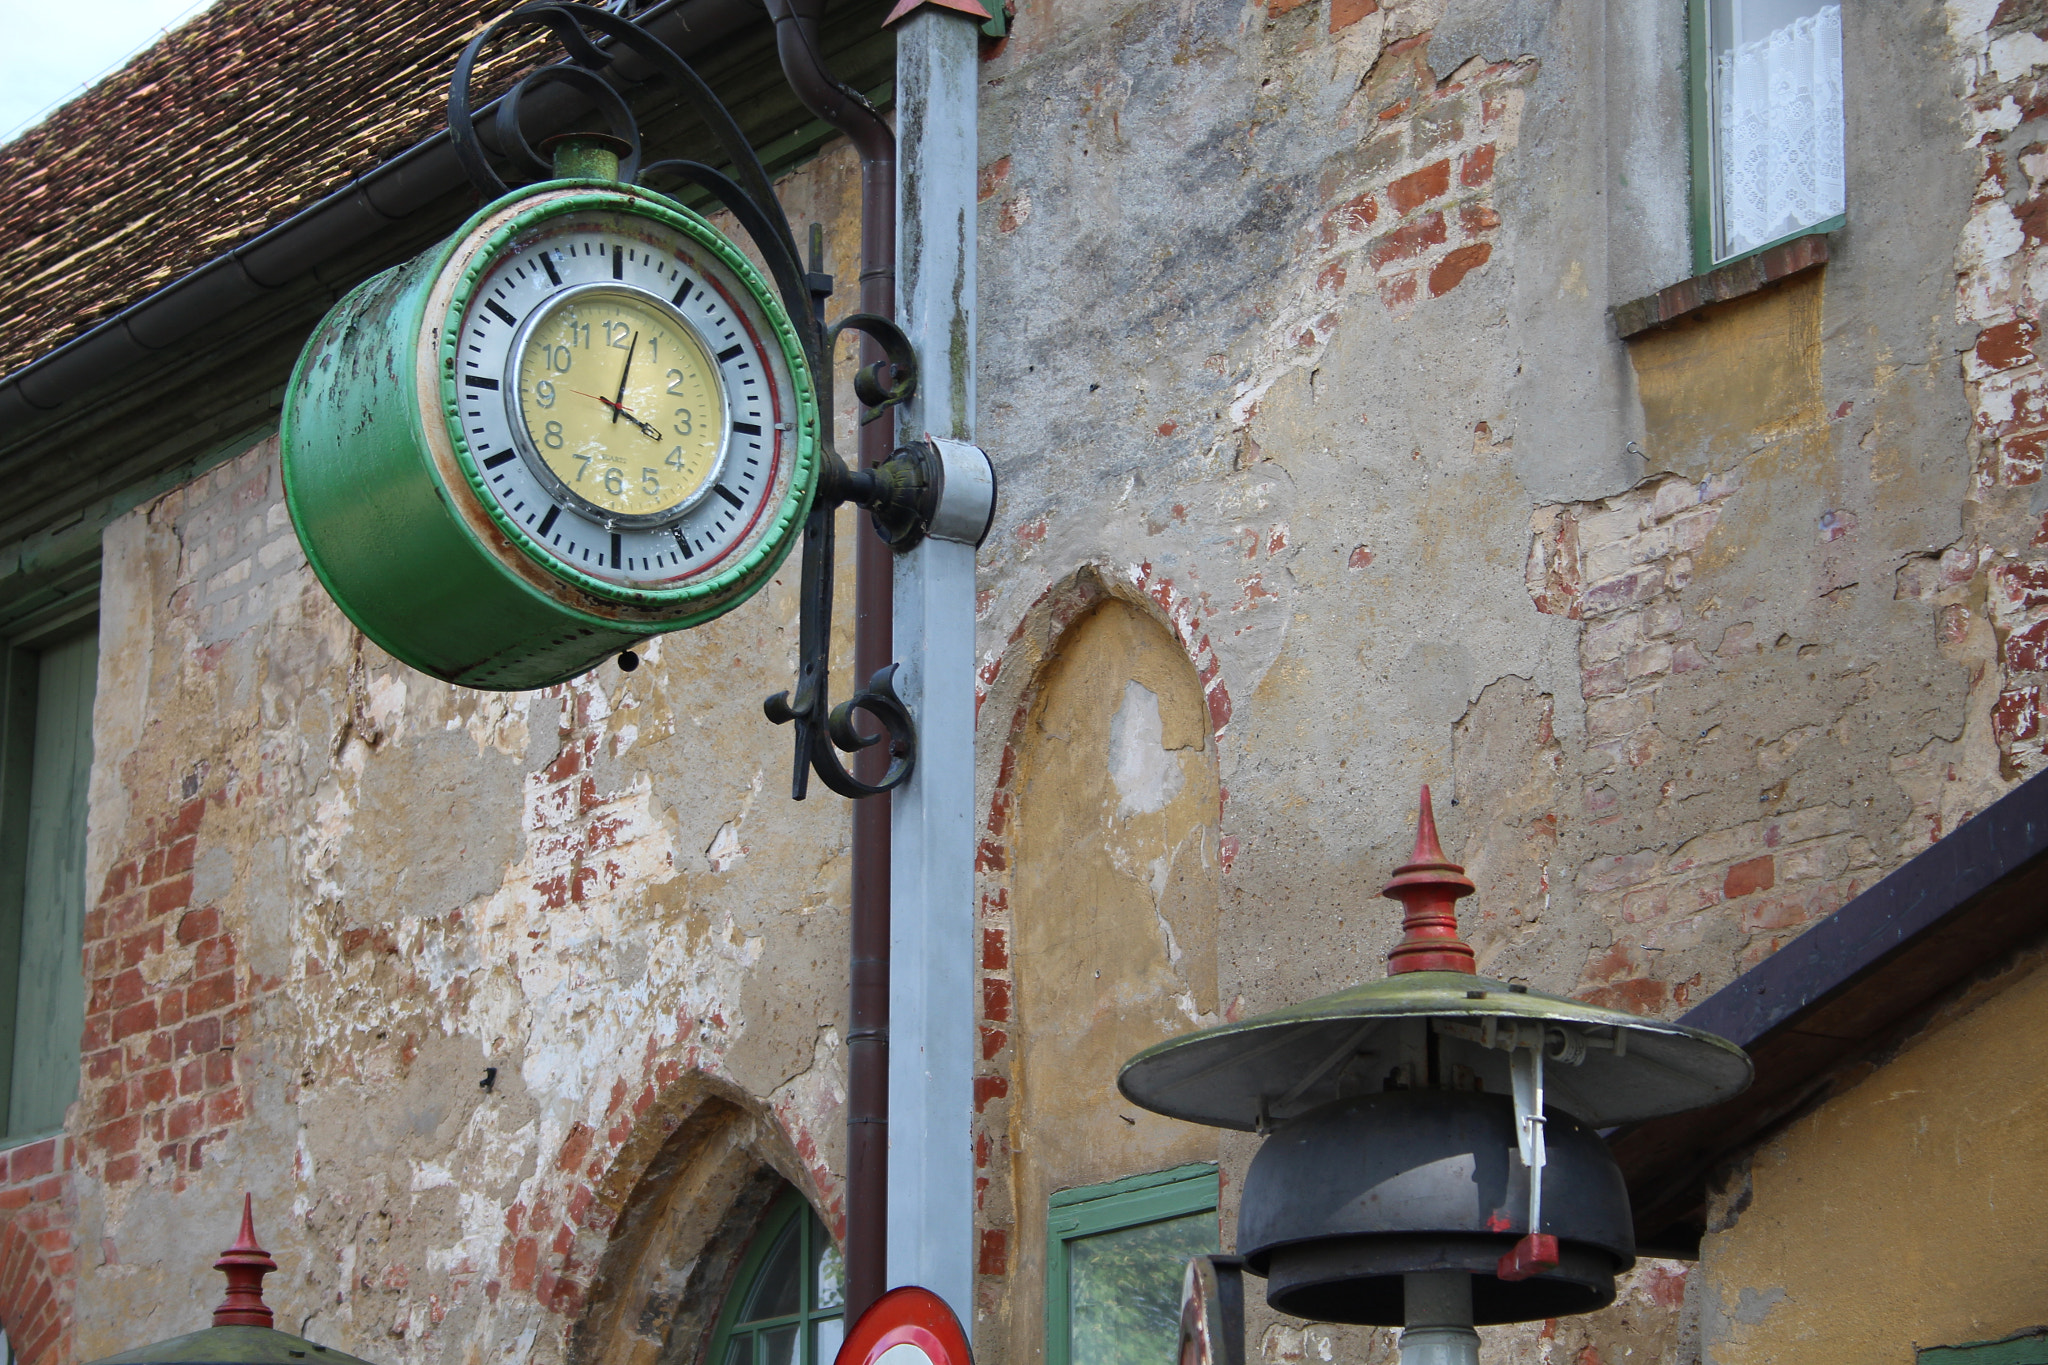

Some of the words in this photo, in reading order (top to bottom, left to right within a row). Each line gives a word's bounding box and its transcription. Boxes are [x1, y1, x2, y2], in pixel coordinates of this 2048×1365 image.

[570, 320, 590, 349] 11
[602, 320, 630, 350] 12
[542, 344, 571, 373] 10
[649, 337, 658, 363] 1
[536, 380, 555, 409] 9
[666, 369, 684, 397] 2
[544, 420, 564, 449] 8
[674, 408, 692, 436] 3
[572, 454, 591, 482] 7
[665, 446, 685, 472] 4
[604, 468, 624, 495] 6
[641, 467, 660, 496] 5
